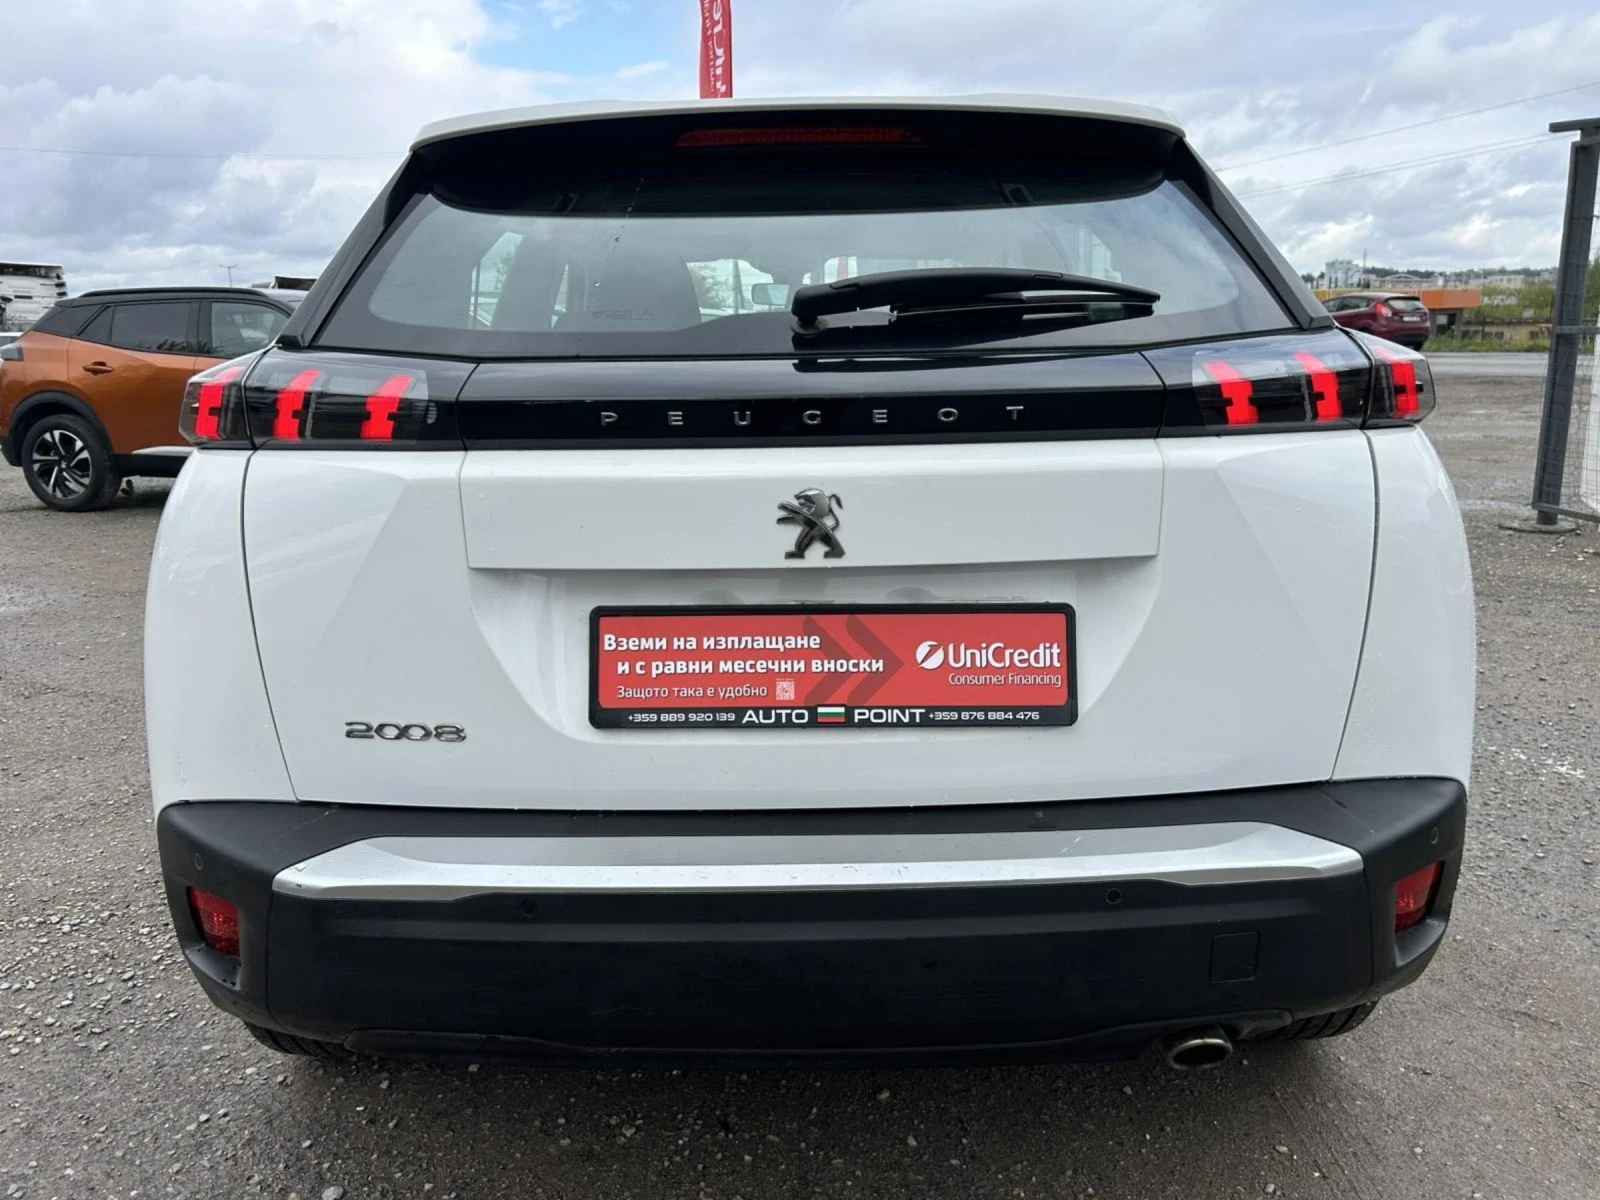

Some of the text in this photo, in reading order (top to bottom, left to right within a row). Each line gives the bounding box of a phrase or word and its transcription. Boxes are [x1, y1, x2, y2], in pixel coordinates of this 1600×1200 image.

[601, 406, 1024, 425] PEUGEOT
[604, 634, 821, 652] Вземи на изплащане
[948, 642, 1061, 668] UniCredit
[617, 659, 884, 677] и с равни месечни вноски
[949, 673, 1062, 688] Consumer Financing
[617, 683, 768, 699] Защото така е удобно
[628, 709, 1040, 724] +359 889 920 139 AUTO POINT +359 876 884 476
[345, 722, 467, 742] 2008
